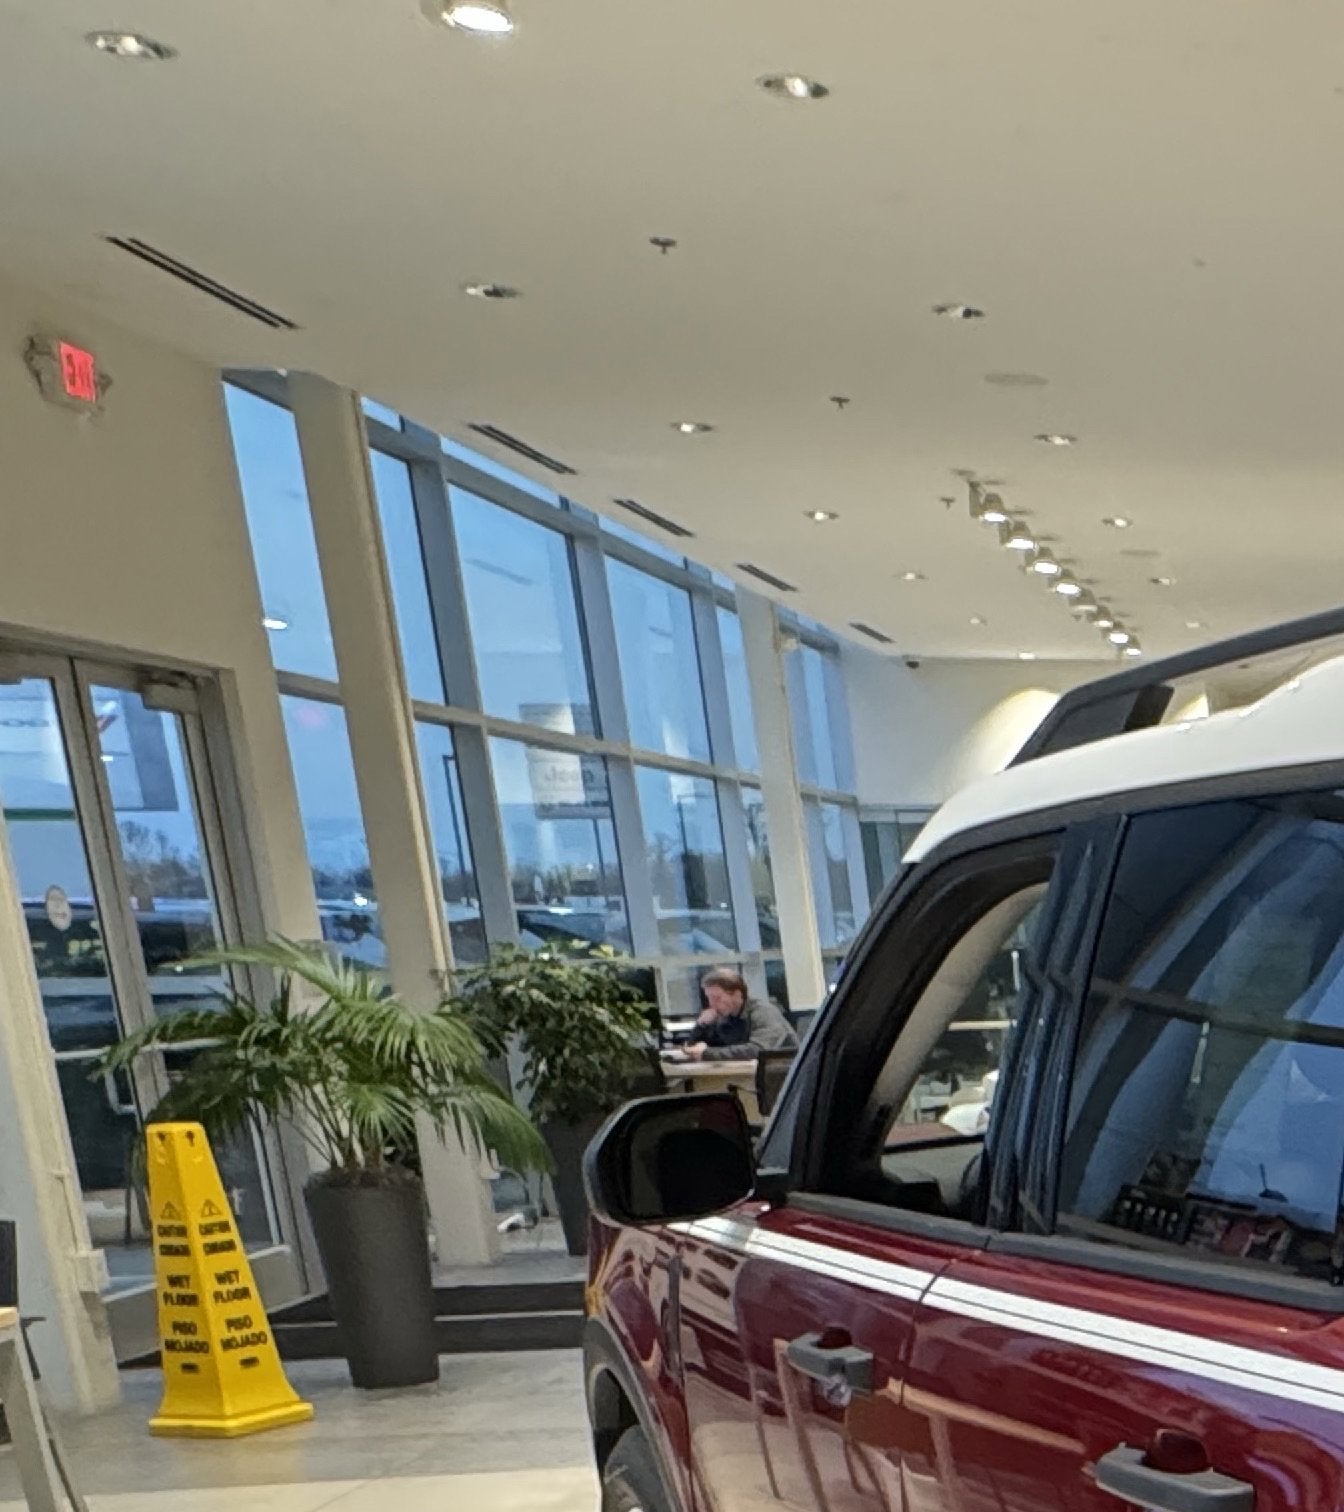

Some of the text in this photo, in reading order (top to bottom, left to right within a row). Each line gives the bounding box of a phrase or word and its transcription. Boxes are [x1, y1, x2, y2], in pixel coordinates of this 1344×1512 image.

[167, 1275, 191, 1288] WET
[214, 1269, 240, 1285] WET
[163, 1292, 199, 1307] FLOOR
[213, 1287, 251, 1303] FLOOR
[164, 1339, 209, 1353] MOJADO
[221, 1331, 267, 1350] MOJADO
